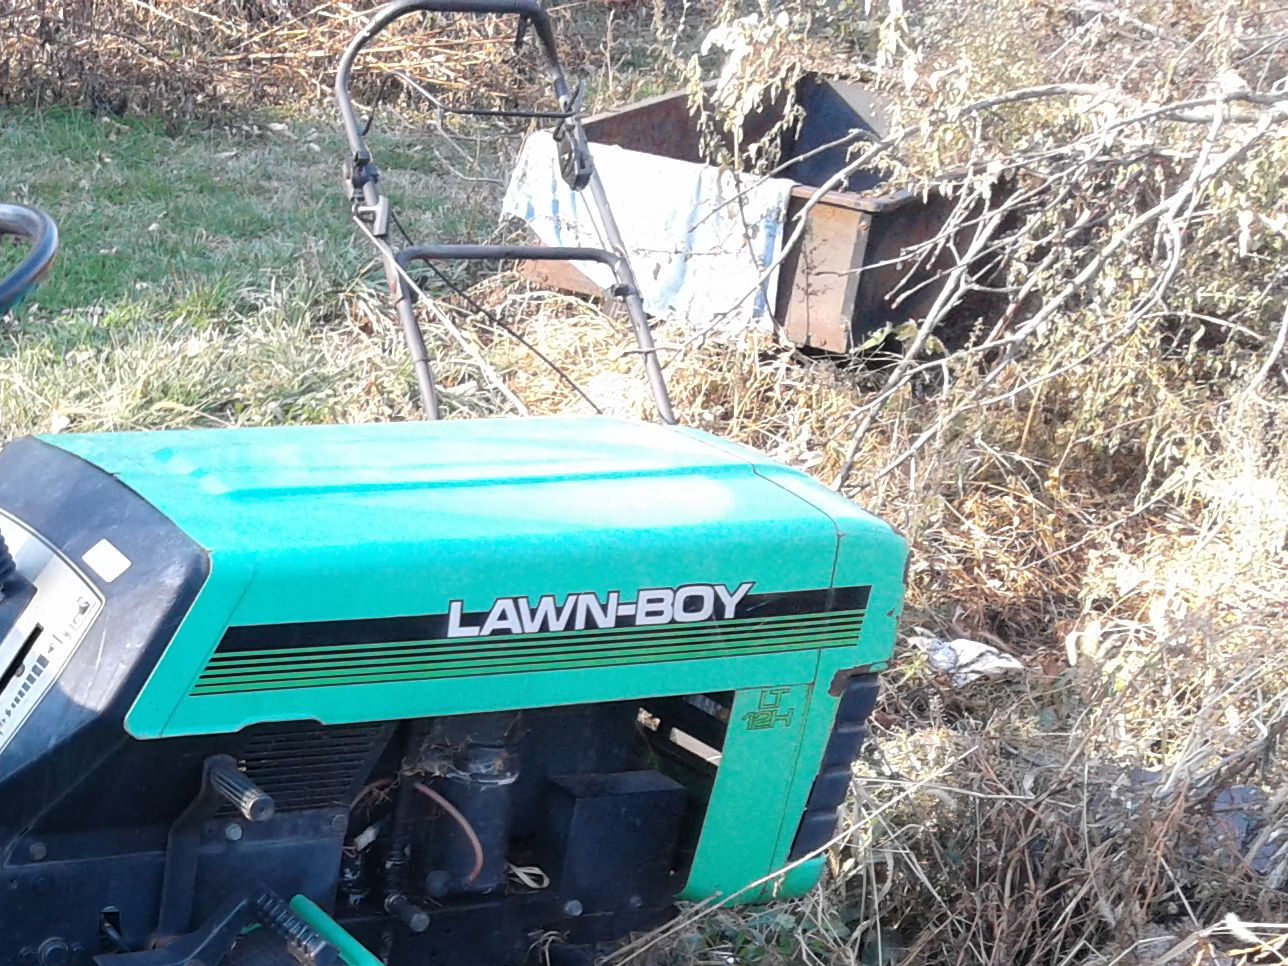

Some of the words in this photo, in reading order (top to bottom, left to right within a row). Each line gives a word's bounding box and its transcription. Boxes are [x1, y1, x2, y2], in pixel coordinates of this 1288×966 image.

[446, 581, 756, 638] LAWN-BOY
[758, 687, 791, 710] LT
[741, 708, 794, 731] 12H
